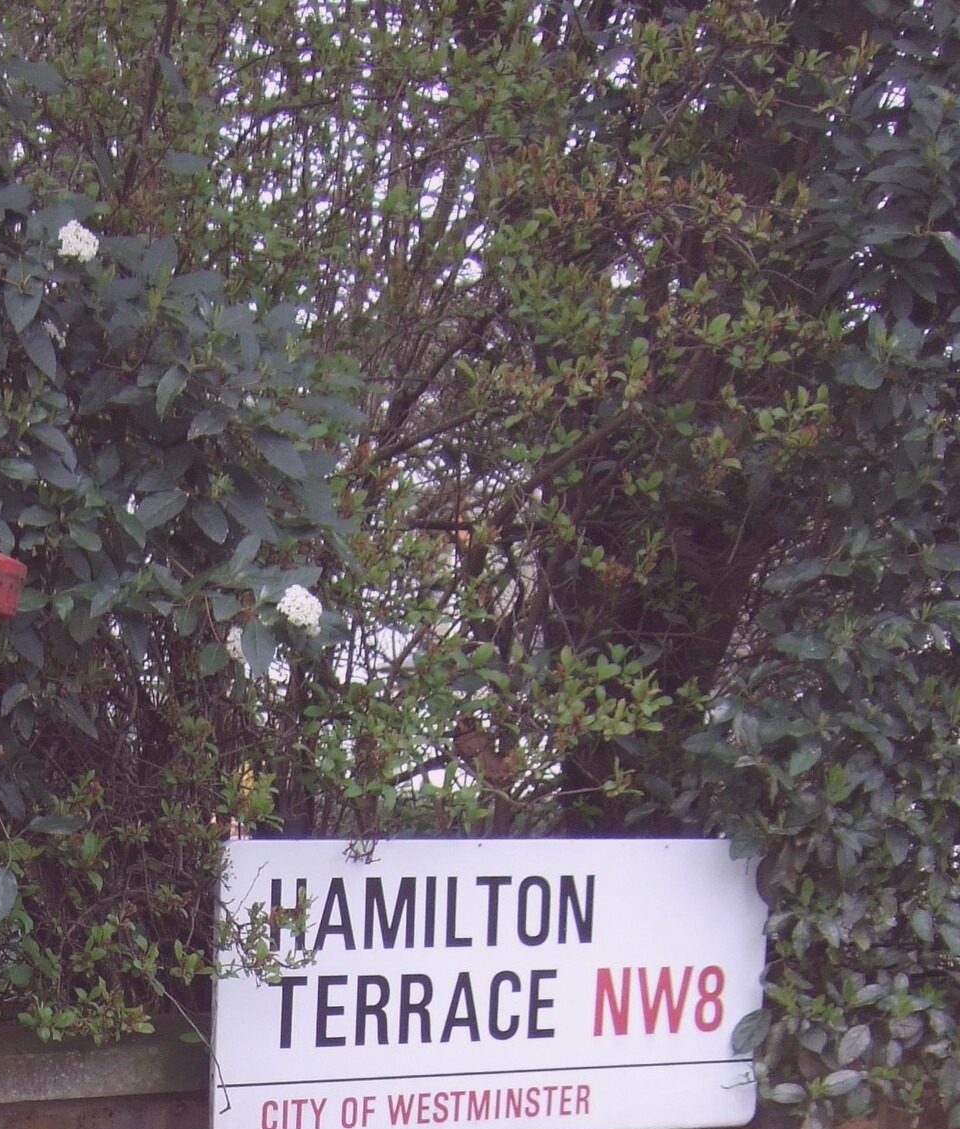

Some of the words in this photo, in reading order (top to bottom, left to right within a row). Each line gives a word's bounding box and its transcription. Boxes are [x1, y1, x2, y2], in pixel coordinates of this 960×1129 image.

[269, 874, 596, 952] HAMILTON
[269, 969, 558, 1049] TERRACE
[592, 965, 725, 1037] NW8
[340, 1095, 377, 1129] OF
[387, 1085, 591, 1126] WESTMINSTER
